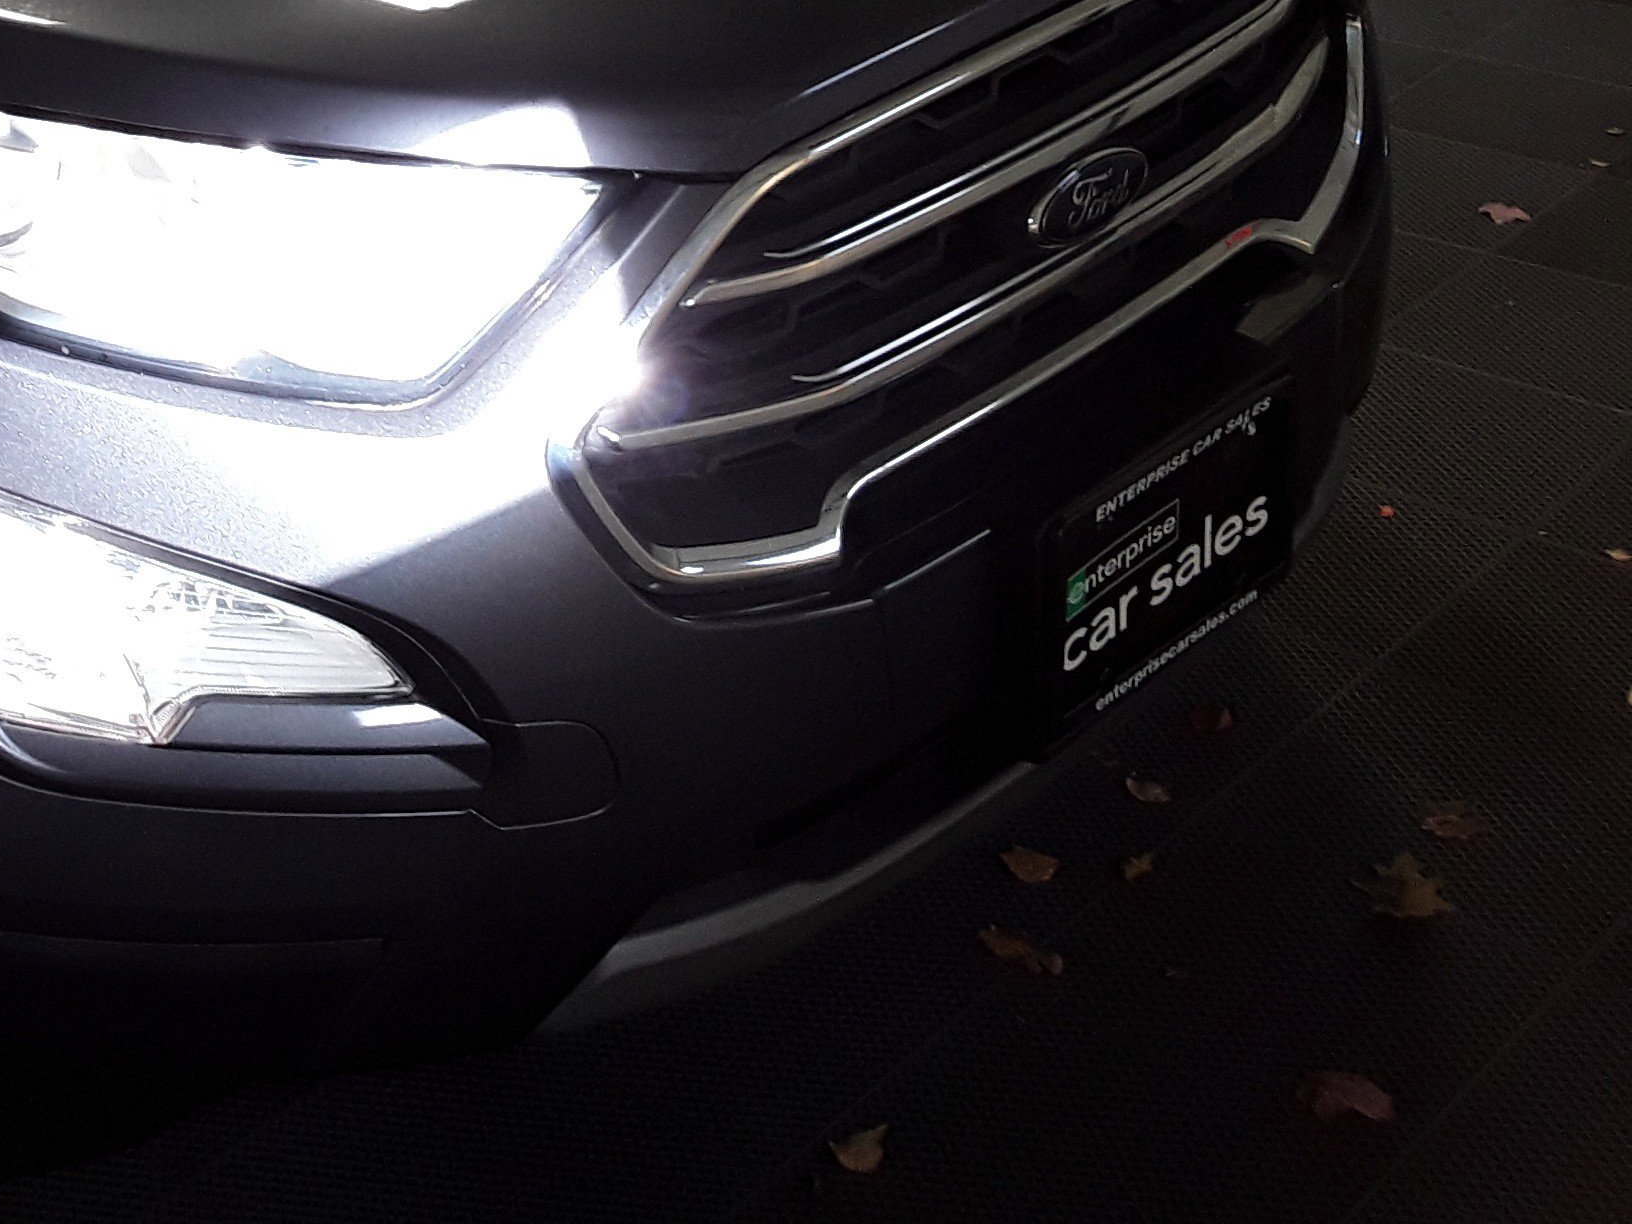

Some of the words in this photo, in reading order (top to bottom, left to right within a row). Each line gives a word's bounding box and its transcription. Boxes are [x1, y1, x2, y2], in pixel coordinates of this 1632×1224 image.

[1067, 167, 1130, 231] Ford
[1095, 448, 1191, 523] ENTERPRISE
[1191, 427, 1223, 456] CAR
[1062, 584, 1139, 672] car
[1148, 494, 1270, 607] sales
[1066, 514, 1178, 605] enterprise
[1094, 588, 1259, 712] enterprisecarsales.com
